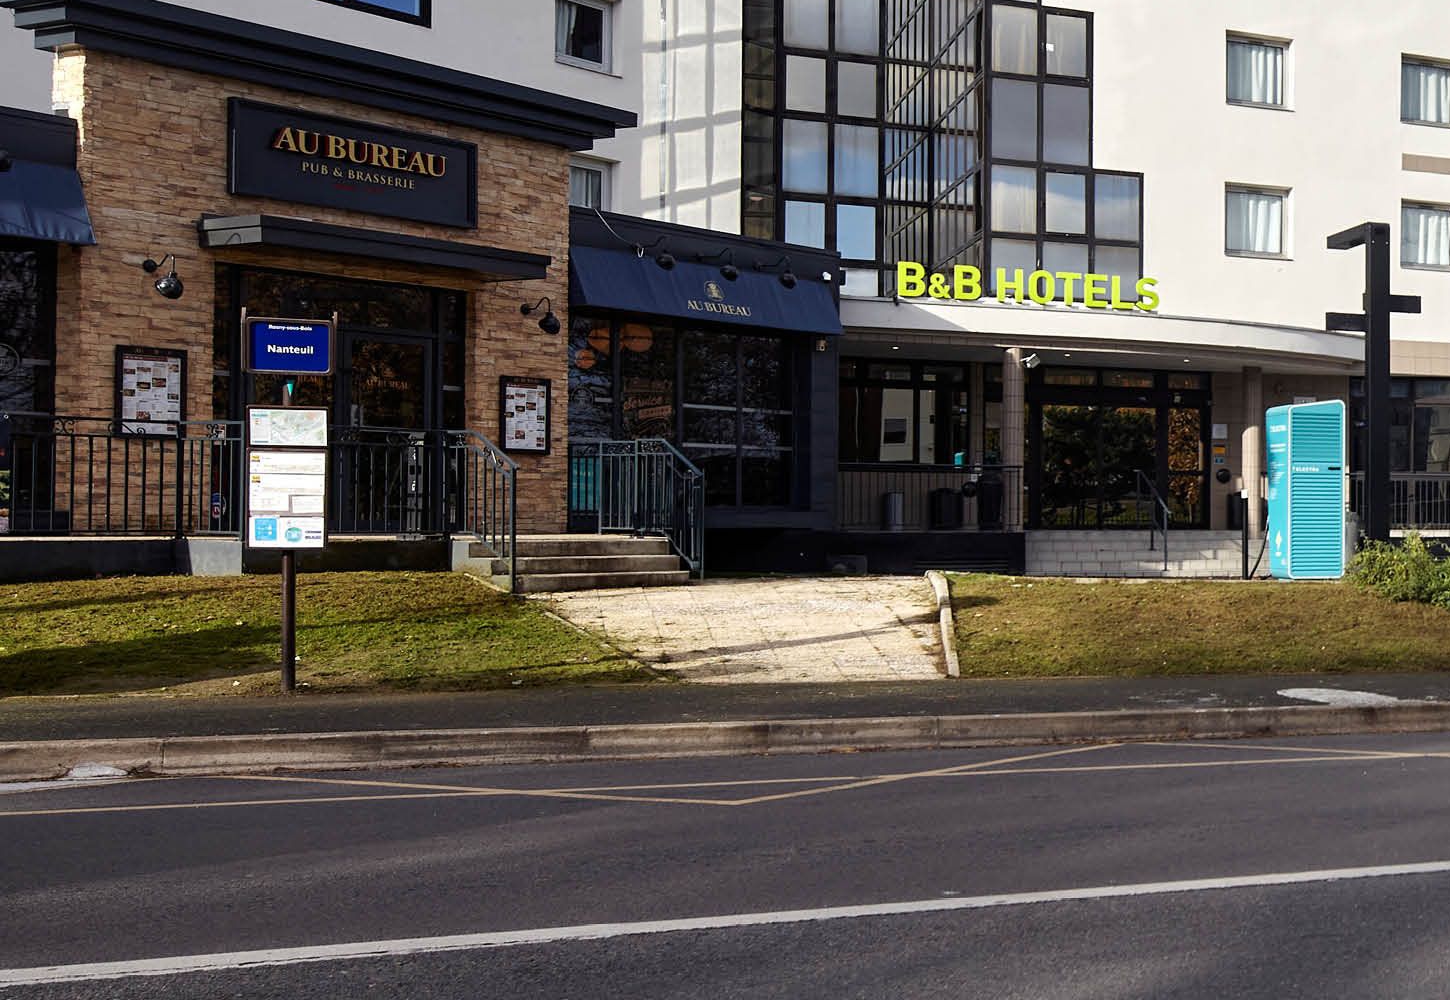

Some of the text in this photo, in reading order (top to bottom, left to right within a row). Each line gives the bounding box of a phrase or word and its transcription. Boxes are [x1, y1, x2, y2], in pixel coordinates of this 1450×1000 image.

[275, 127, 448, 177] AU BUREAU
[302, 161, 329, 175] PUB
[333, 167, 343, 178] &
[348, 169, 416, 190] BRASSERIE
[897, 261, 1160, 311] B&B HOTELS
[687, 299, 752, 317] AU BUREAU
[267, 344, 314, 355] Nanteuil
